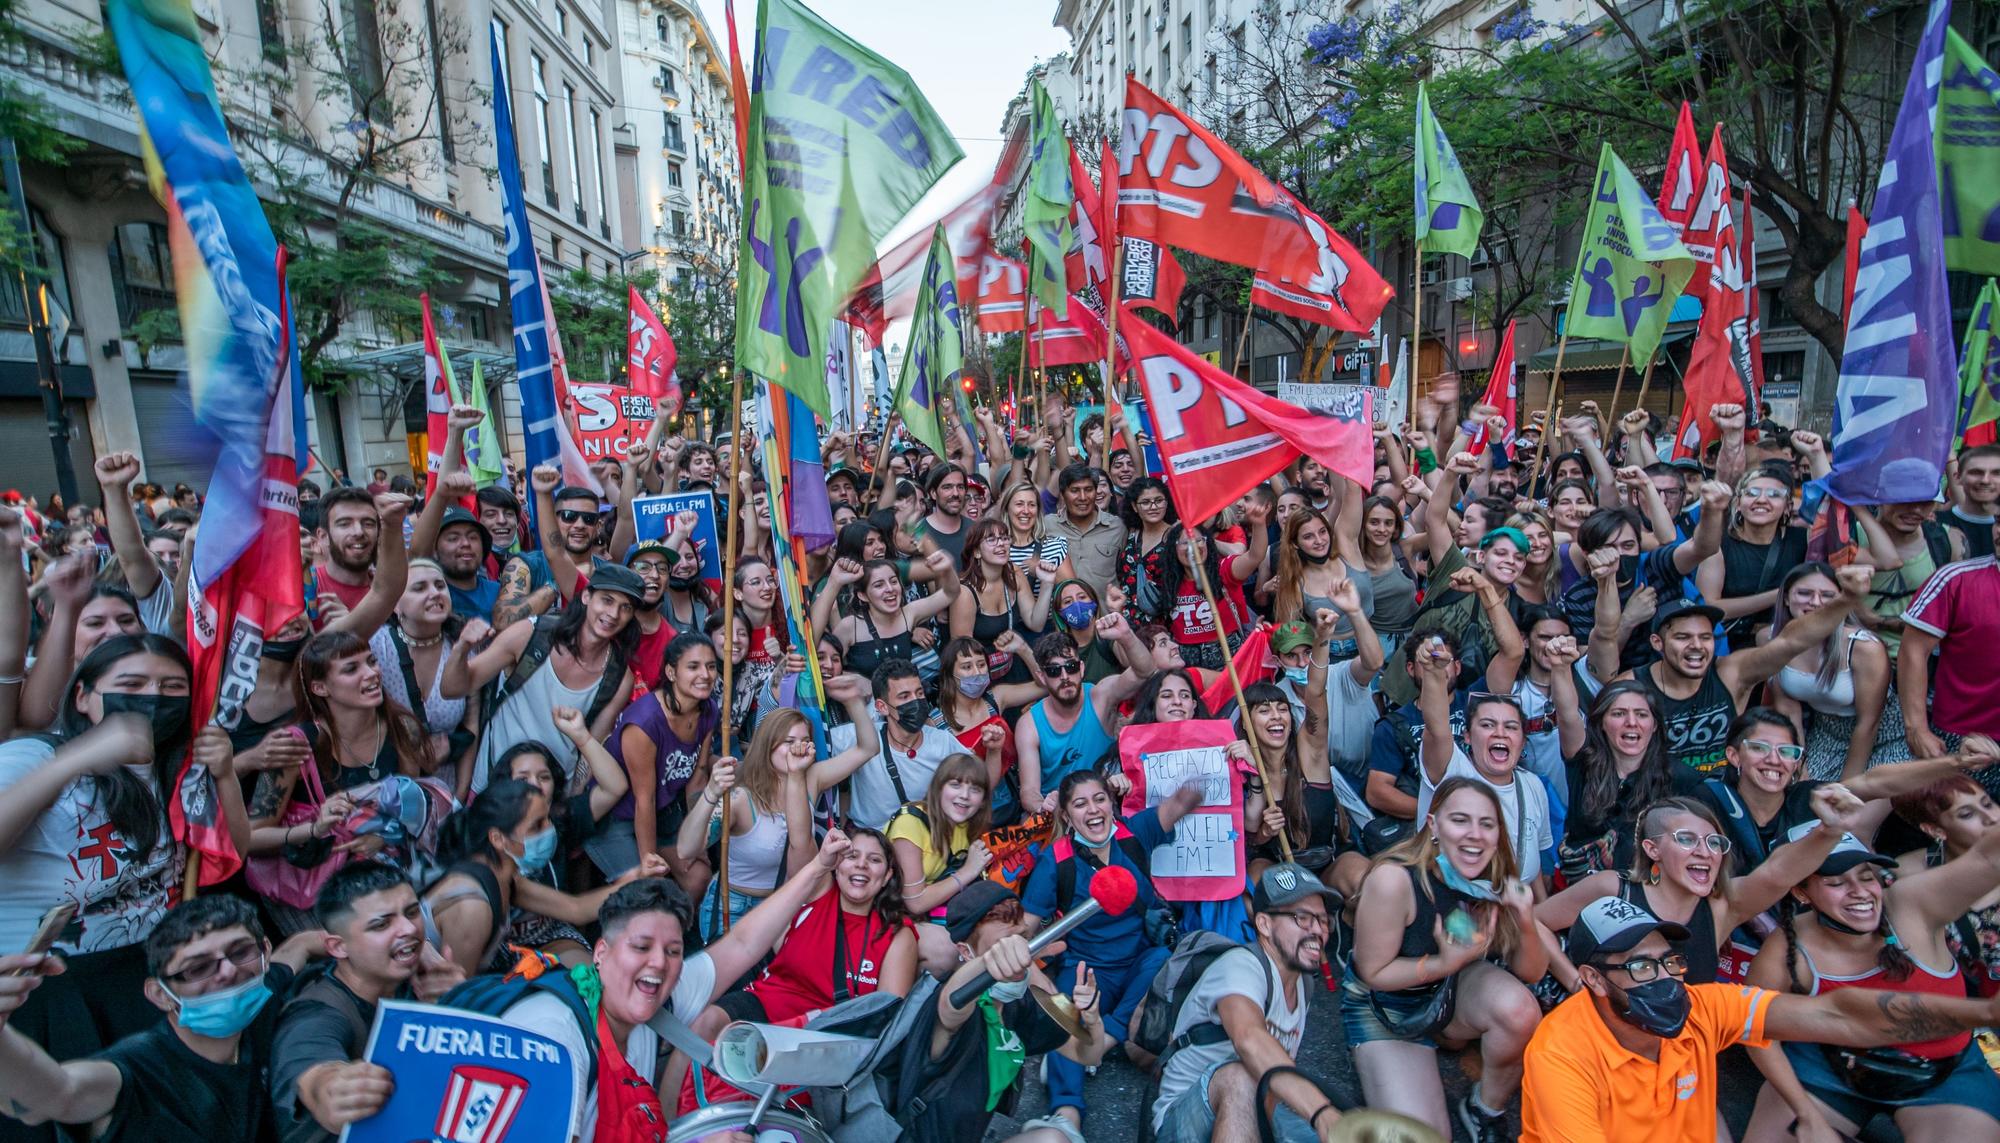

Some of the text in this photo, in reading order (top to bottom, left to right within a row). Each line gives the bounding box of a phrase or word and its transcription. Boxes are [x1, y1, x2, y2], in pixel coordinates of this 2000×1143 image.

[788, 45, 931, 170] RED
[1119, 108, 1222, 187] PTS
[979, 255, 1024, 297] PT
[1289, 385, 1303, 395] FMI
[642, 499, 706, 515] FUERA EL FMI
[1148, 750, 1223, 781] RECHAZO
[1205, 816, 1226, 842] EL
[1176, 846, 1214, 872] FMI
[397, 1022, 561, 1064] FUERA EL FMI
